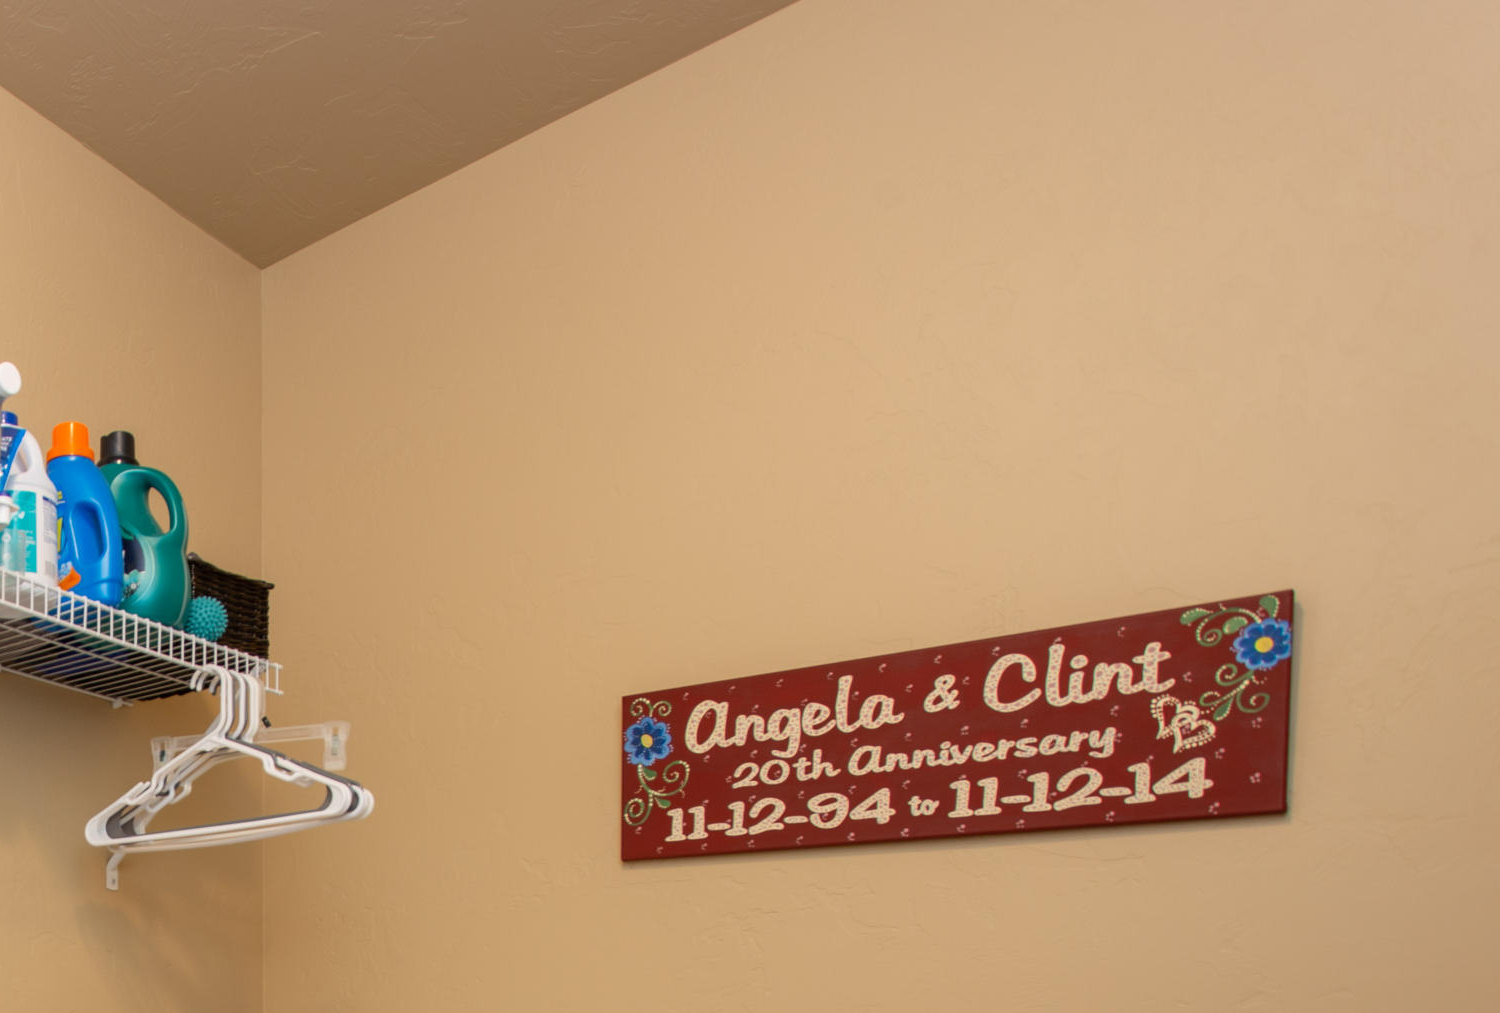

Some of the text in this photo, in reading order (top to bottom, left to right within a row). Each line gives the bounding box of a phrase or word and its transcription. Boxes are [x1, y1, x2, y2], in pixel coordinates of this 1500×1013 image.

[684, 640, 1176, 758] Angela & Clint
[664, 756, 1214, 843] 11-12-94 to 11-12-14
[732, 725, 1117, 790] 20th Anniversary
